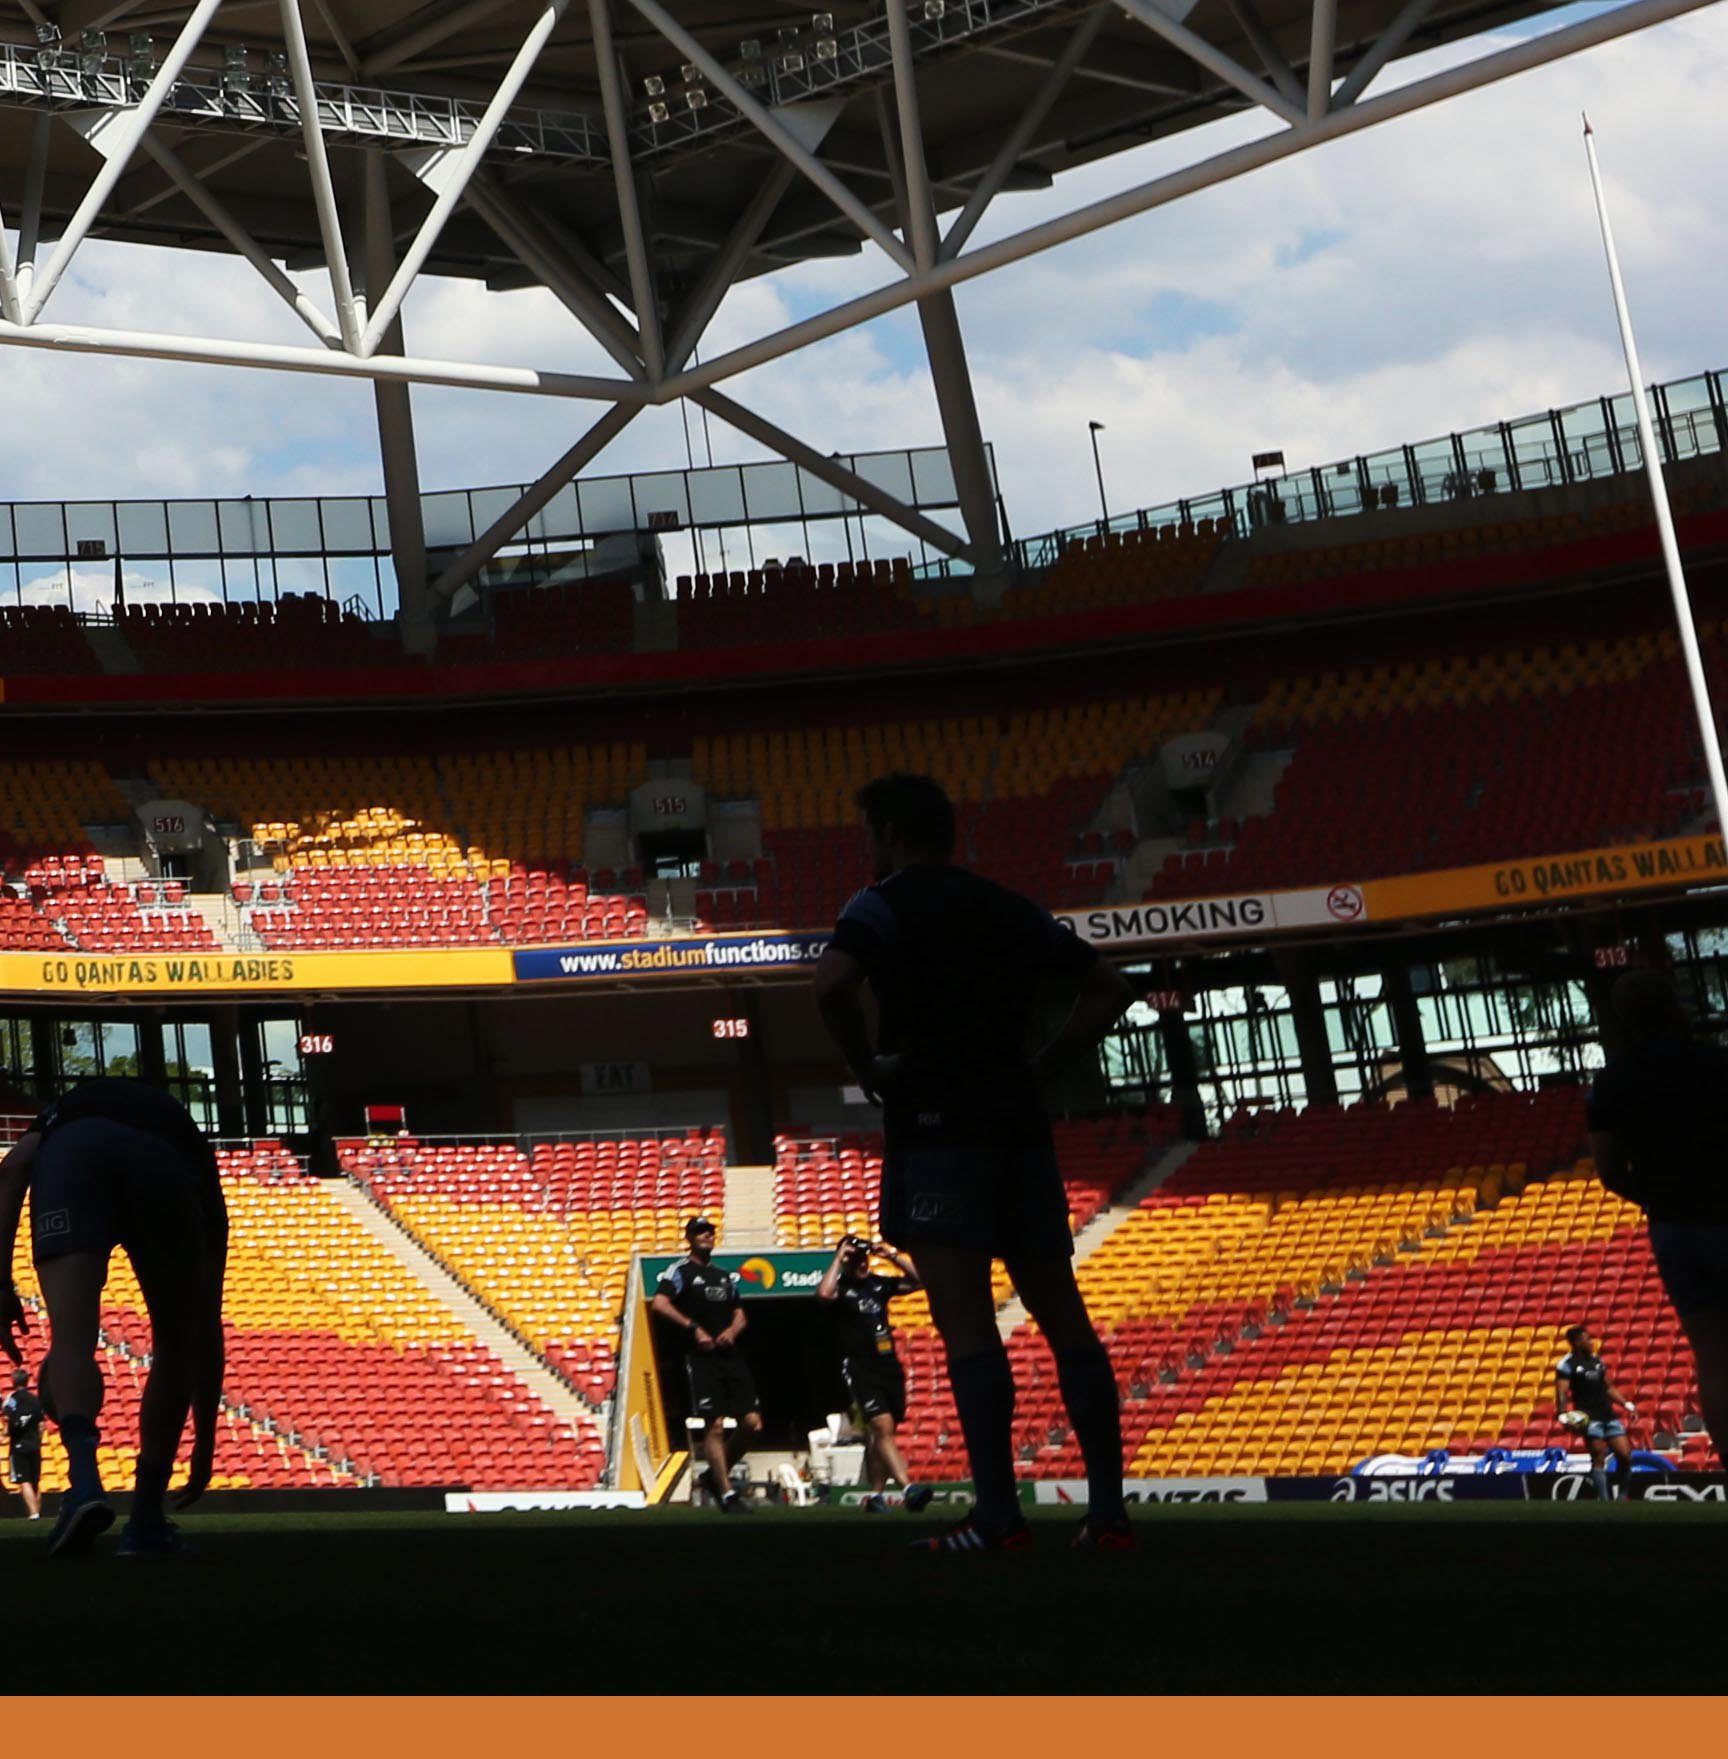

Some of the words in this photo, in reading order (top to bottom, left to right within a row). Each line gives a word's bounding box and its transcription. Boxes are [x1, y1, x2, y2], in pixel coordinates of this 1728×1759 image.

[1494, 869, 1527, 897] GO
[1533, 854, 1628, 895] QANTAS
[1089, 898, 1265, 939] SMOKING
[42, 960, 69, 983] GO
[75, 961, 157, 988] QANTAS
[165, 959, 294, 983] WALLABIES
[713, 1019, 748, 1038] 315
[300, 1035, 333, 1054] 316
[782, 1270, 825, 1288] Stadi
[1123, 1489, 1247, 1504] ANTAS
